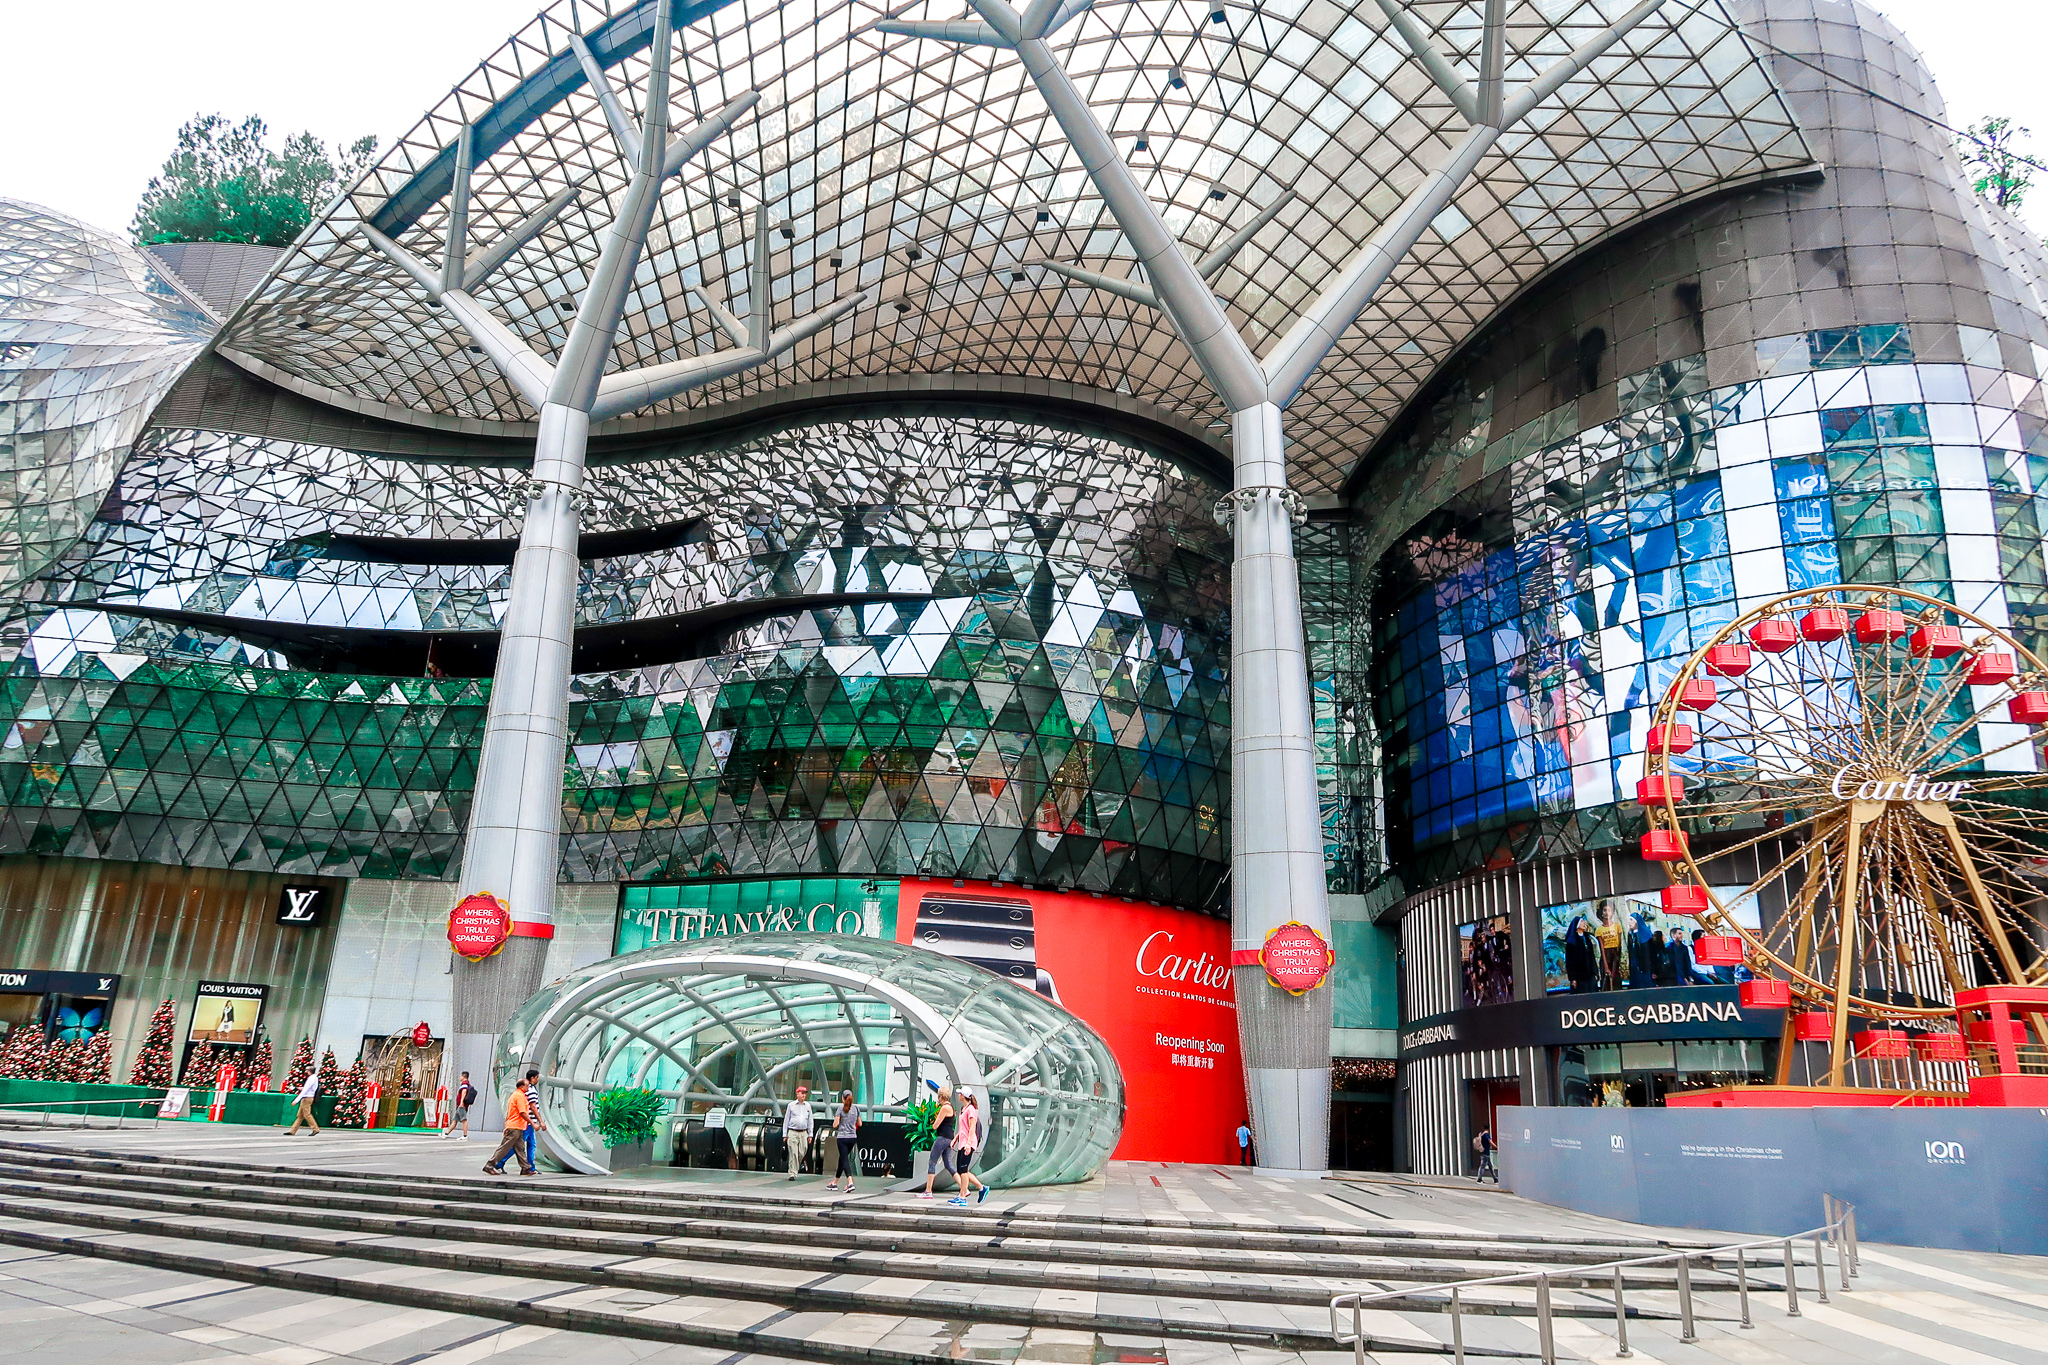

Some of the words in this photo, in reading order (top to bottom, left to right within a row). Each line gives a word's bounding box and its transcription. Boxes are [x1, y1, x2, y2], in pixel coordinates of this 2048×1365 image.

[1832, 762, 1972, 801] Cartier
[464, 909, 494, 917] WHERE
[455, 917, 501, 926] CHRISTMAS
[647, 908, 772, 943] TIFFANY
[775, 906, 801, 932] &
[464, 926, 490, 934] TRULY
[455, 934, 496, 943] SPARKLES
[1279, 939, 1312, 948] WHERE
[1272, 948, 1321, 957] CHRISTMAS
[1284, 958, 1311, 966] TRULY
[1275, 967, 1320, 975] SPARKLES
[200, 984, 225, 993] LOUIS
[226, 985, 263, 996] VUITTON
[1136, 985, 1181, 998] COLLECTION
[1182, 992, 1206, 1003] SANTOS
[1208, 997, 1216, 1005] DE
[1560, 1006, 1616, 1029] DOLCE
[1617, 1014, 1627, 1026] &
[1627, 1001, 1742, 1025] GABBANA
[1155, 1032, 1205, 1054] Reopening
[1206, 1038, 1225, 1054] Soon
[1696, 1145, 1719, 1153] bringing
[1735, 1146, 1764, 1154] Christmas
